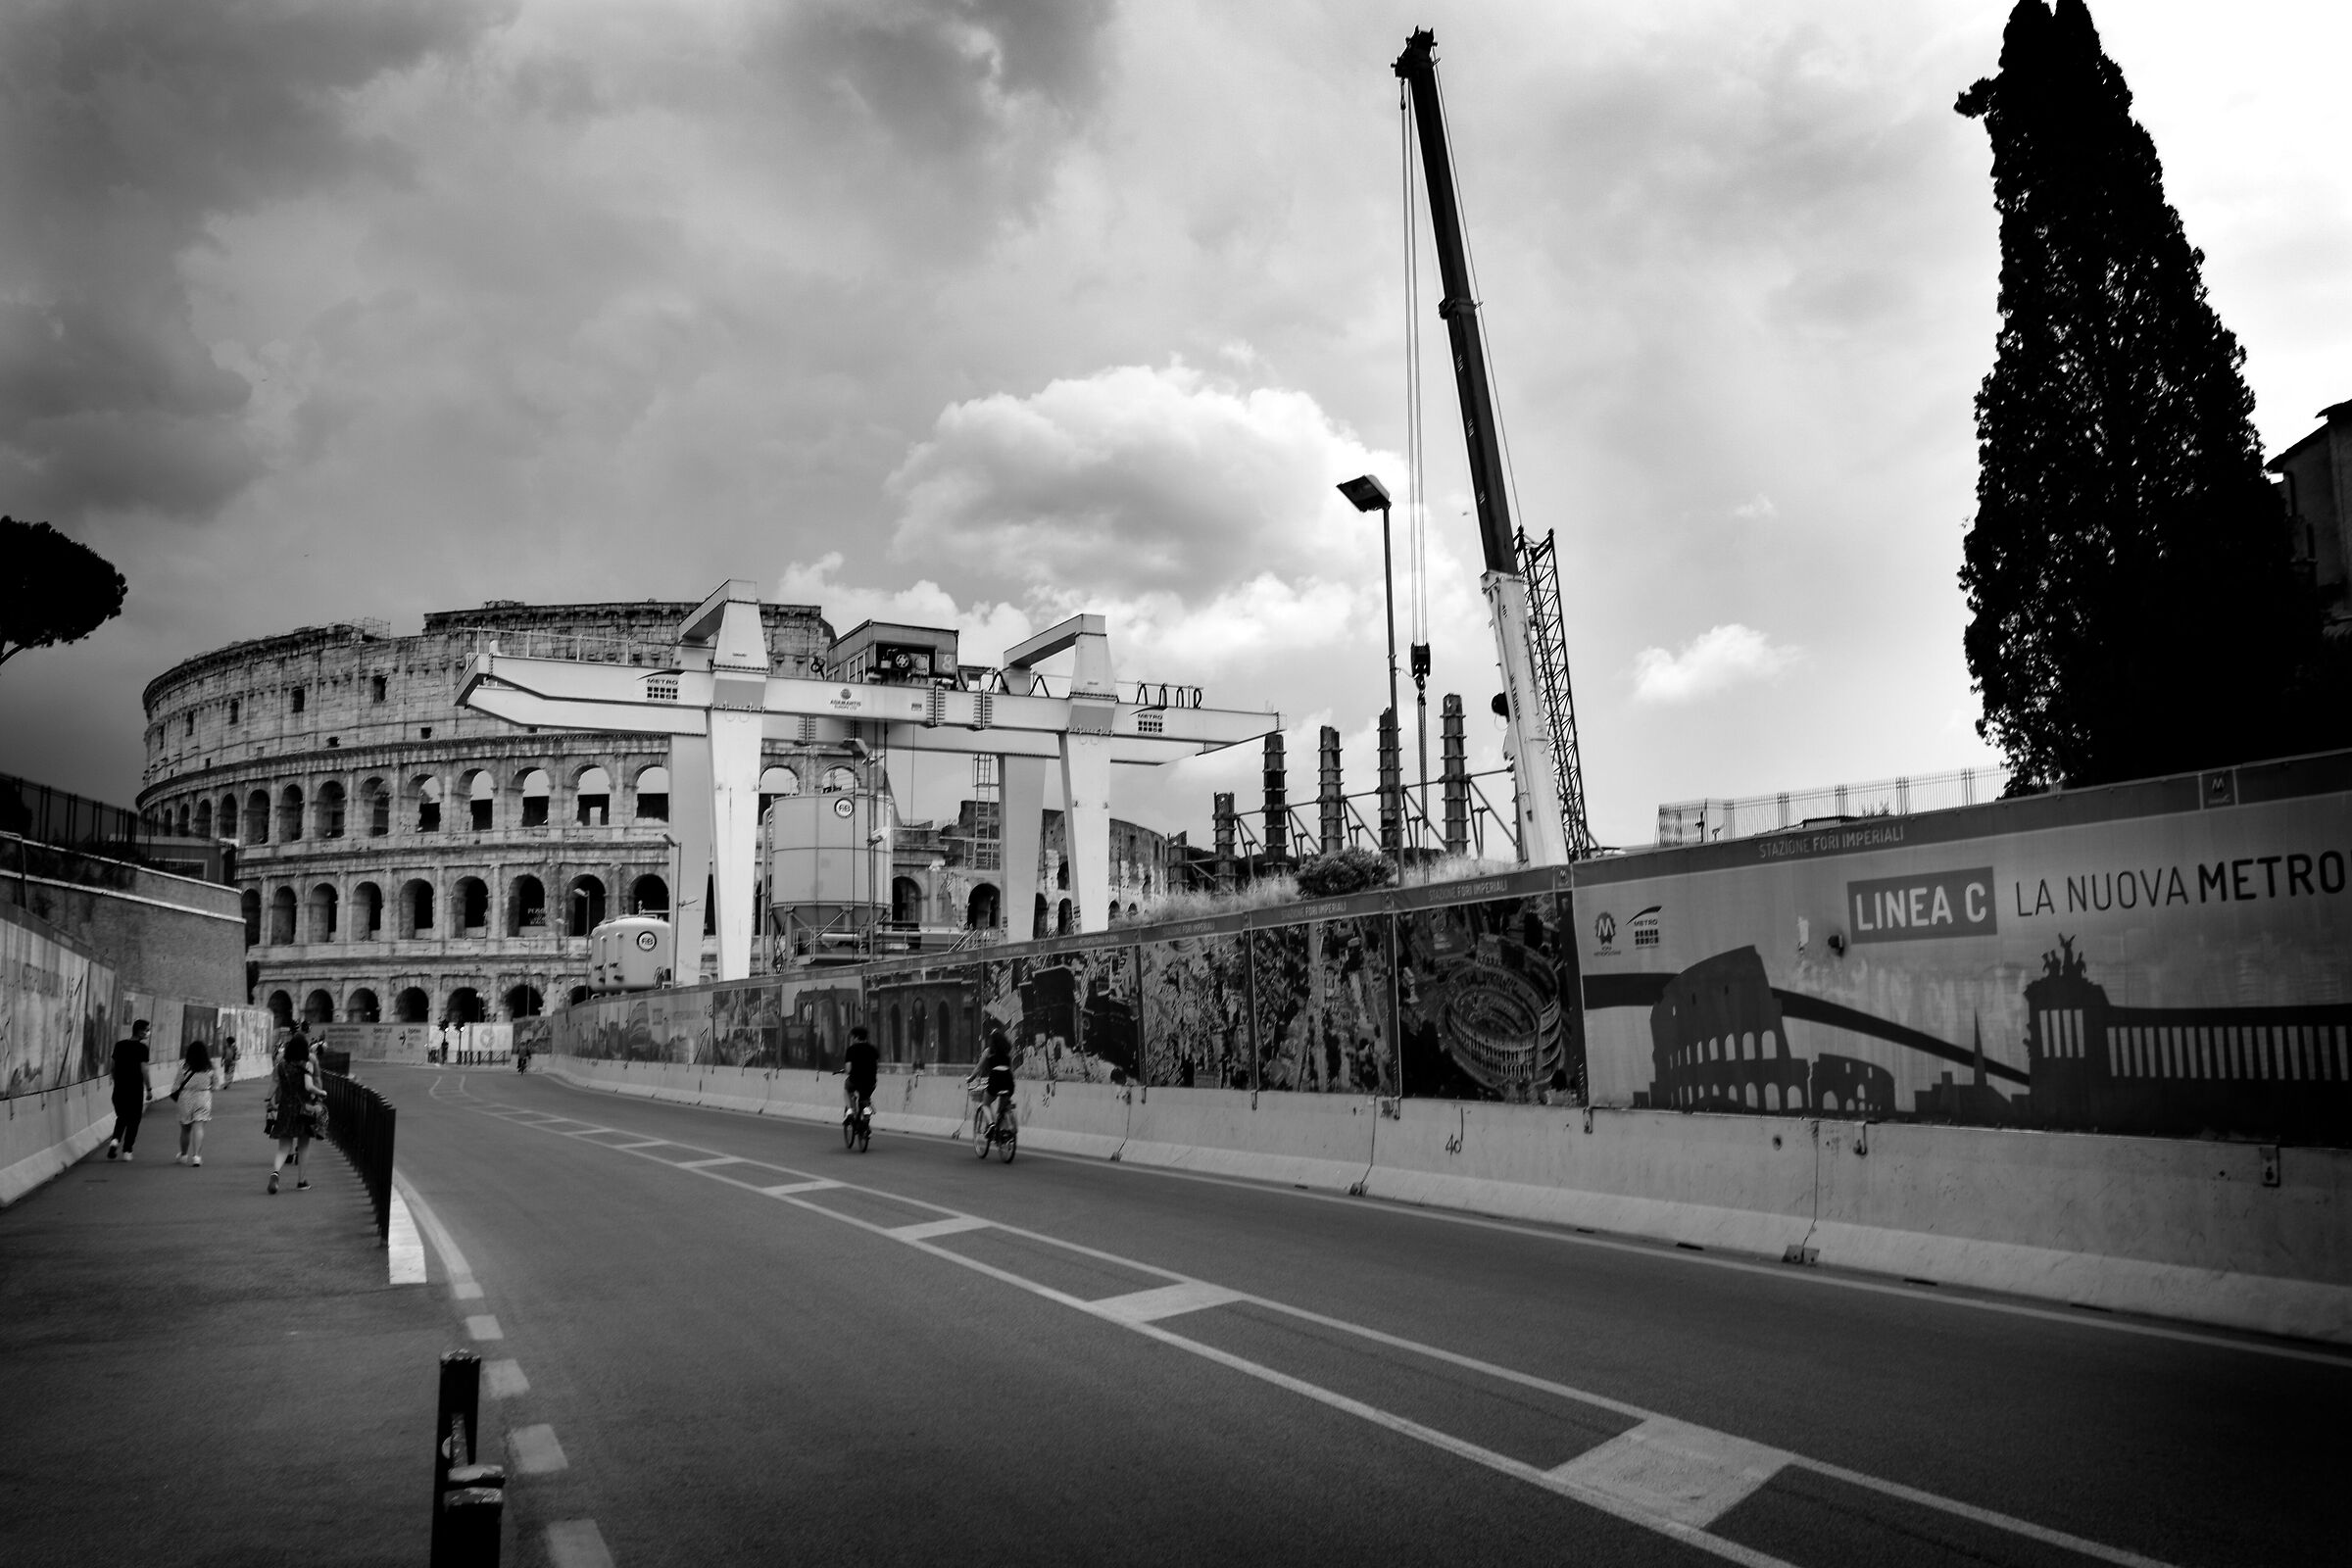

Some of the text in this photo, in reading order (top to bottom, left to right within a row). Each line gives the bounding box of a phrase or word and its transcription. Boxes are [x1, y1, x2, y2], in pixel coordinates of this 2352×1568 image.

[1759, 824, 1904, 858] STAZIONE FORI IMPERIALI
[1473, 878, 1508, 895] IMPERIALI
[2016, 850, 2352, 916] LA NUOVA METRO
[1856, 882, 1986, 931] LINEA C
